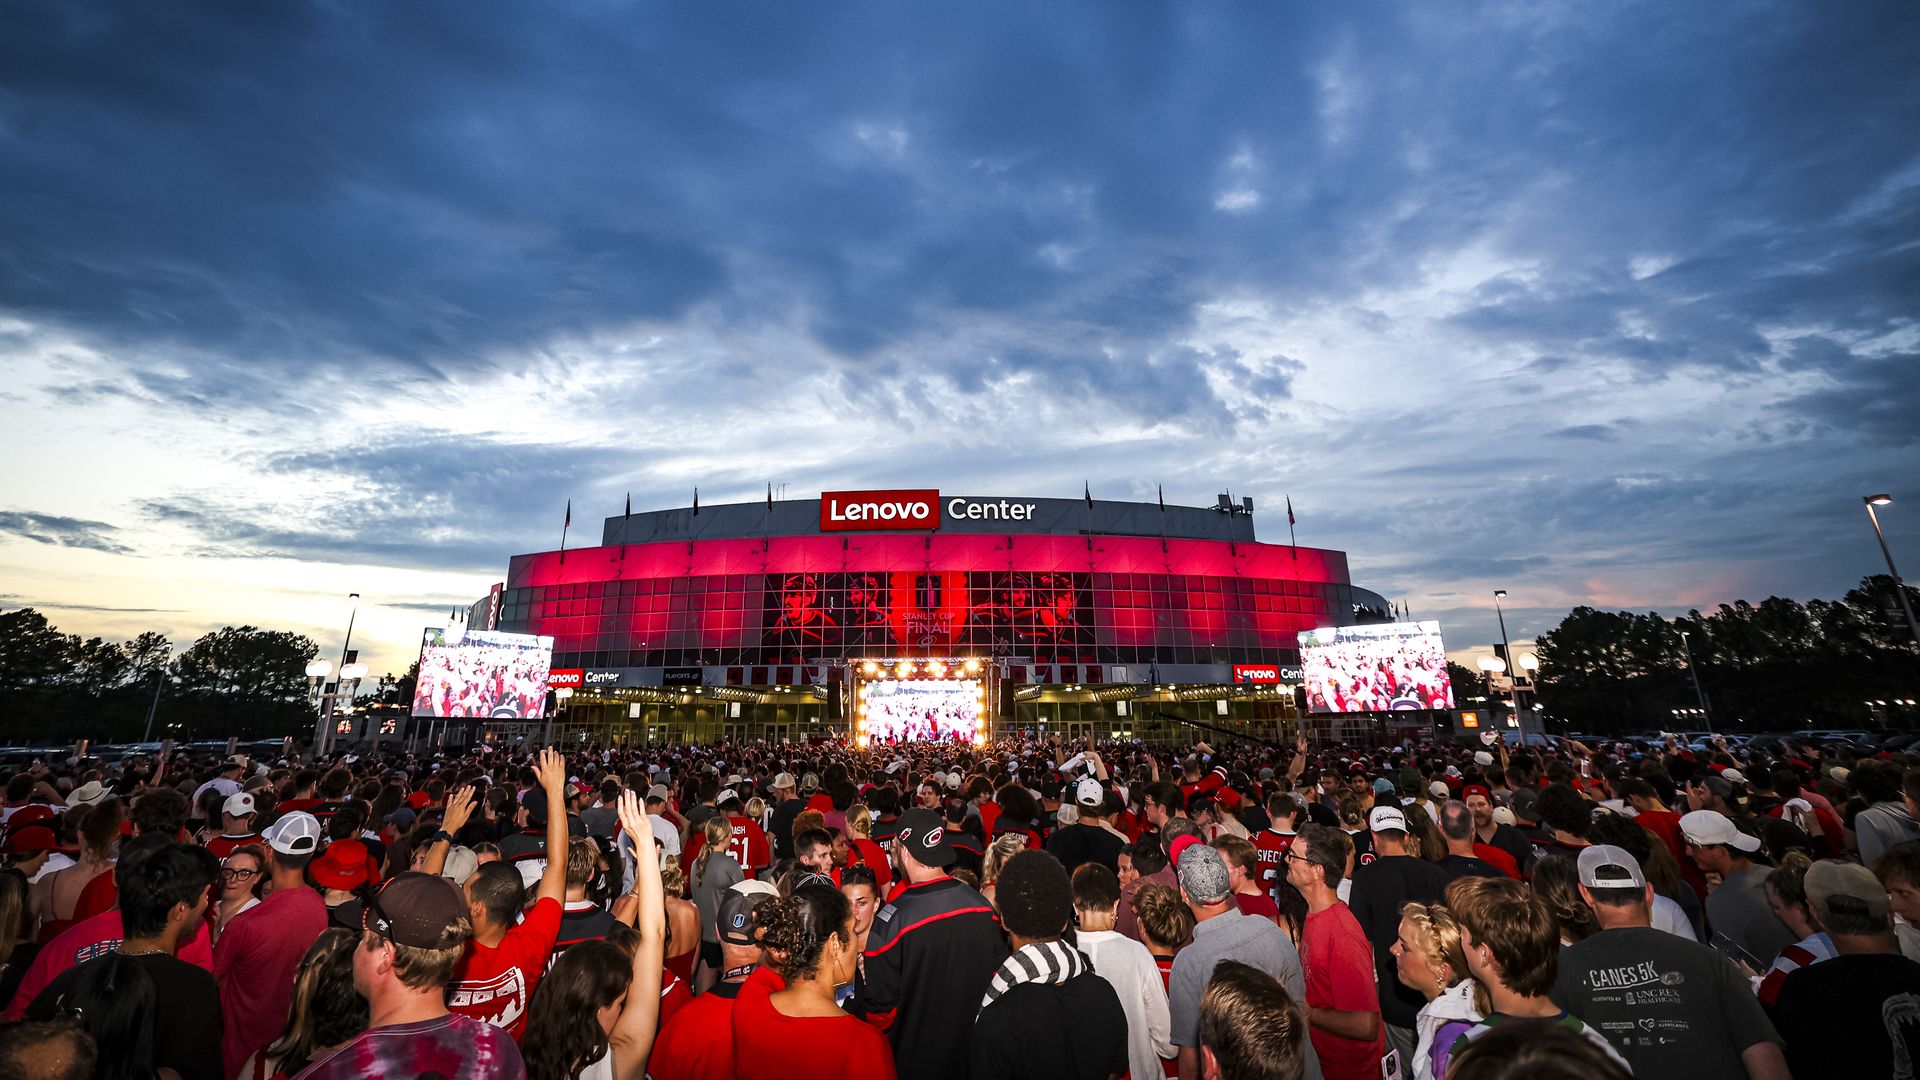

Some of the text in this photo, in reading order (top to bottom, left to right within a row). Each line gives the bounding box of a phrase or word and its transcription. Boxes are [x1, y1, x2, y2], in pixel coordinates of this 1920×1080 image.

[830, 498, 1036, 521] Lenovo Center
[488, 591, 498, 630] ovo
[902, 612, 955, 620] STANLEY CUP
[907, 621, 950, 634] FINAL
[548, 673, 580, 684] enovo
[1280, 668, 1304, 679] Cent
[1589, 960, 1659, 987] CANES 5K
[1636, 988, 1680, 999] UNC REX
